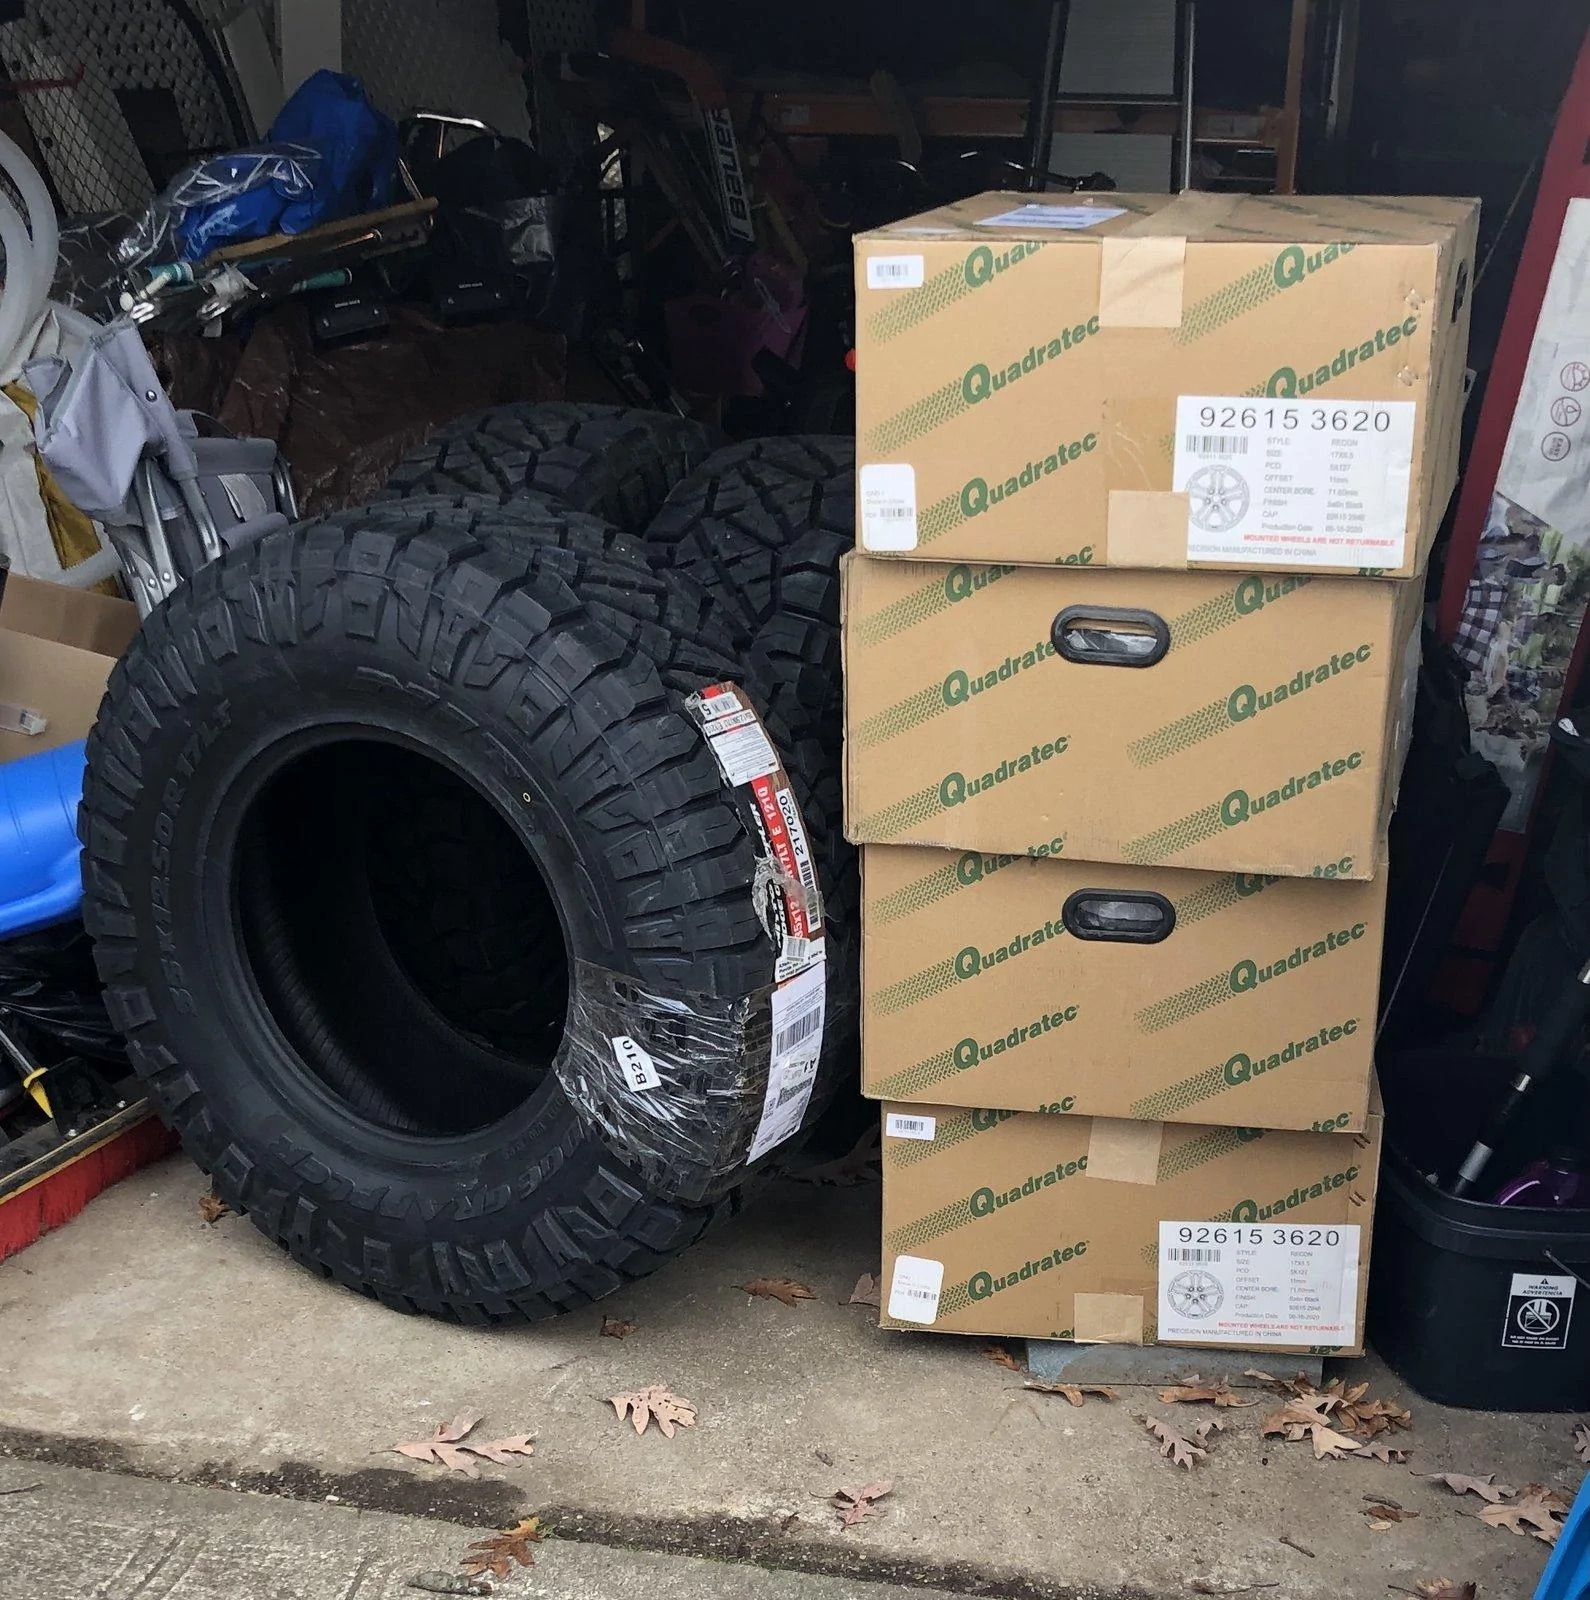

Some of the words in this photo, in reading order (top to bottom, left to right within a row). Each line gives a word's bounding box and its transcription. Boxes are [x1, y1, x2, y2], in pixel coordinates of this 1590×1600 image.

[962, 314, 1100, 404] Quadratec
[1199, 407, 1299, 430] 92615
[1311, 408, 1391, 432] 3620
[960, 432, 1098, 517] Quadratec
[1244, 534, 1279, 543] MOUNTED
[1281, 535, 1310, 544] WHEELS
[1328, 537, 1344, 545] NOT
[1346, 538, 1395, 547] RETURNABLE
[1226, 644, 1371, 723] Quadratec
[939, 736, 1069, 807] Quadratec
[1220, 752, 1363, 826] Quadratec
[779, 795, 804, 856] 217020
[1229, 923, 1366, 993] Quadratec
[952, 1007, 1078, 1070] Quadratec
[1223, 1019, 1358, 1087] Quadratec
[969, 1155, 1088, 1218] Quadratec
[1179, 1227, 1263, 1244] 92615
[1273, 1229, 1340, 1246] 3620
[967, 1241, 1087, 1302] Quadratec
[1202, 1329, 1254, 1337] MANUFACTURED
